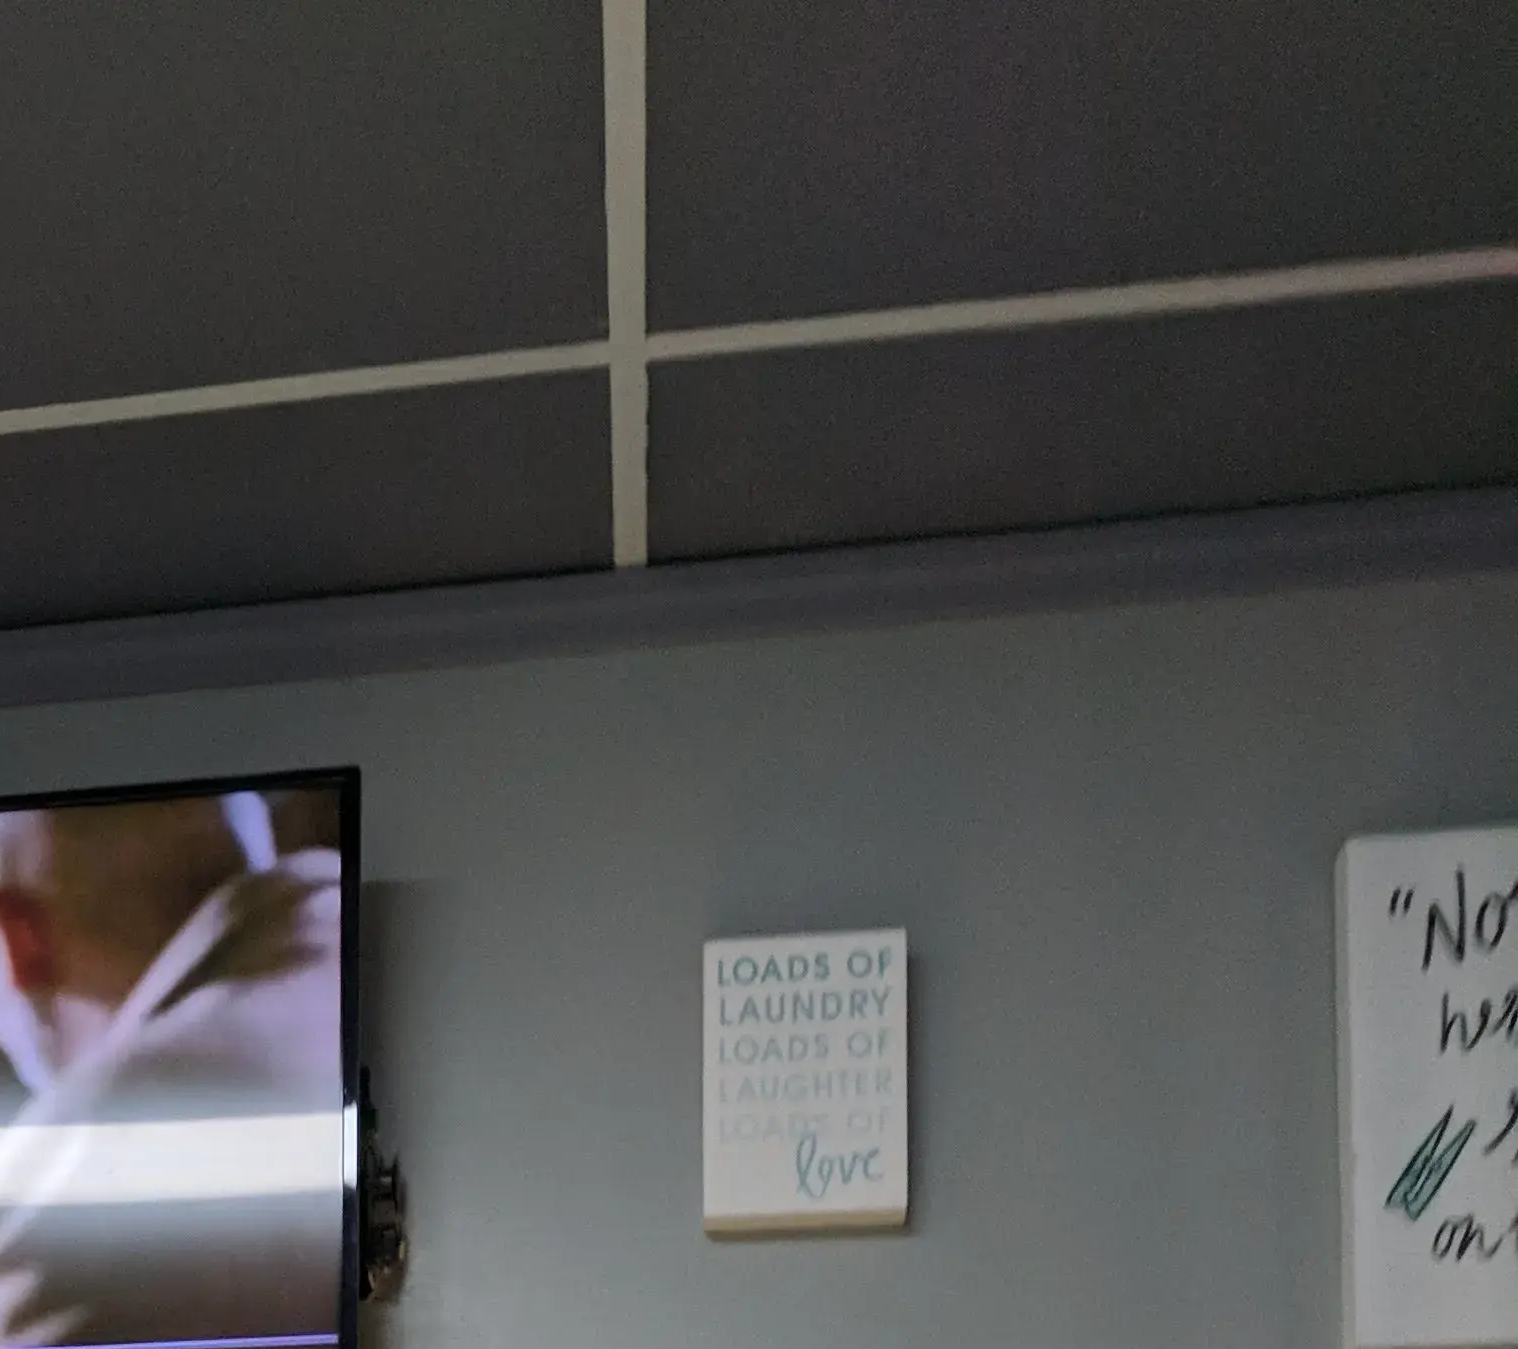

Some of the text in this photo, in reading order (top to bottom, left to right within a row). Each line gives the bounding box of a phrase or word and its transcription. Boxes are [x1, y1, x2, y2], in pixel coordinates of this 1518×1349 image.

[717, 945, 893, 988] LOADS OF
[718, 986, 893, 1027] LAUNDRY
[718, 1027, 893, 1065] LOADS OF
[718, 1067, 894, 1103] LAUGHTER
[720, 1106, 889, 1144] LOADS OF
[795, 1130, 885, 1200] love
